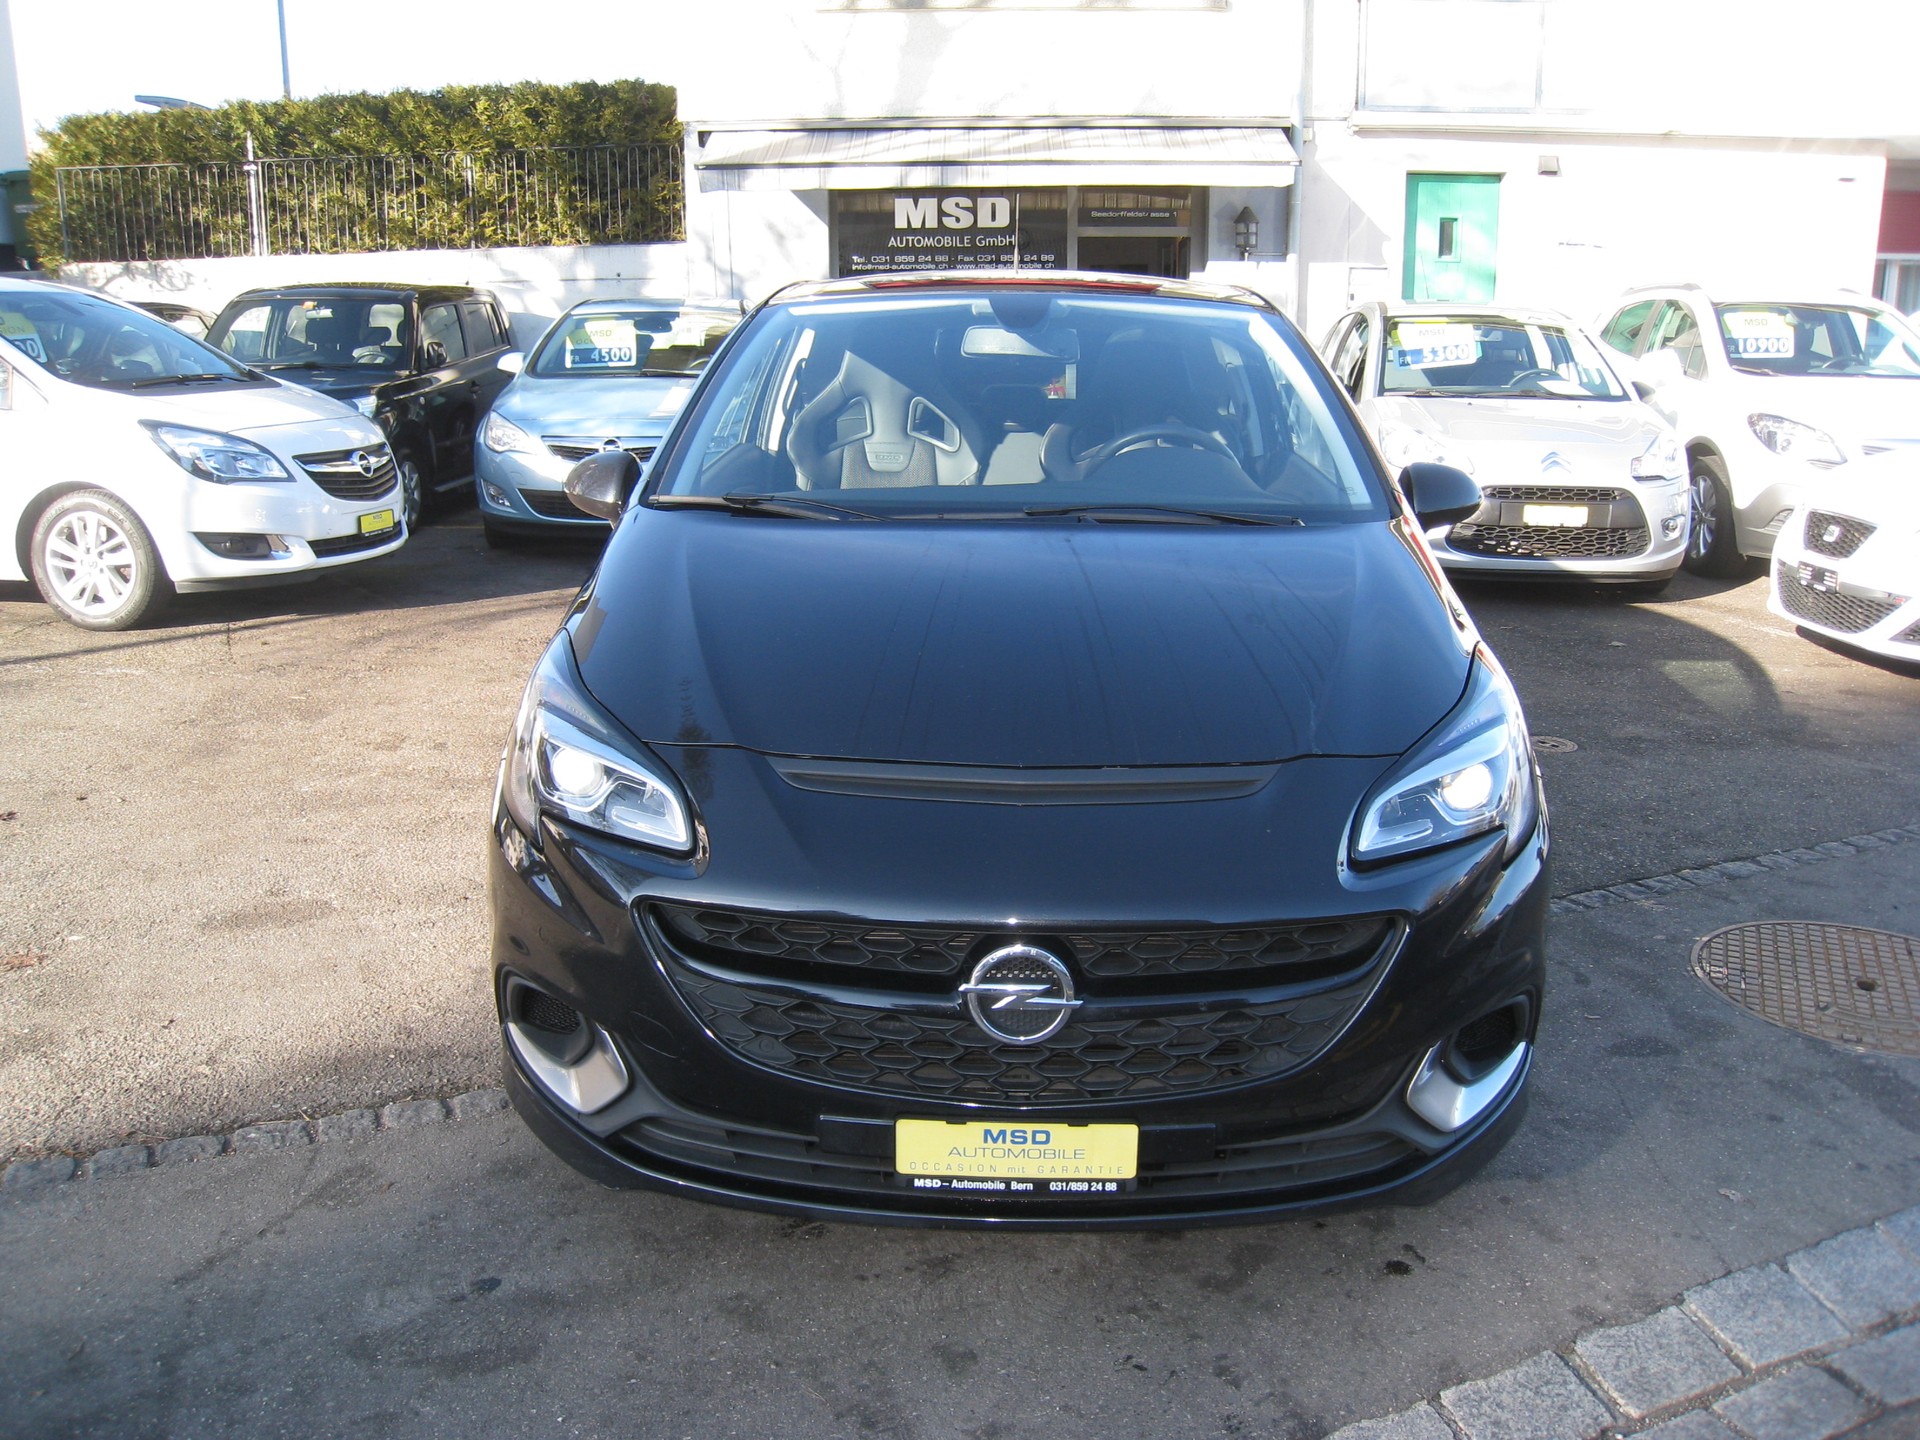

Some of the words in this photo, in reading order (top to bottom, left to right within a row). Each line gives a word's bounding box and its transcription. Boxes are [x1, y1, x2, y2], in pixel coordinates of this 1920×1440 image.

[894, 197, 1010, 229] MSD
[888, 235, 971, 248] AUTOMOBILE
[976, 235, 1015, 247] GmbH
[852, 255, 868, 263] Tel.
[871, 255, 890, 263] 031
[894, 255, 915, 263] 859
[918, 255, 932, 263] 24
[934, 254, 949, 262] 88
[957, 254, 975, 262] Fax
[976, 254, 996, 262] 031
[1000, 254, 1021, 262] 85
[1738, 338, 1789, 353] 10900
[590, 347, 630, 362] 4500
[1422, 344, 1470, 363] 5300
[983, 1129, 1051, 1145] MSD
[947, 1146, 1086, 1160] AUTOMOBILE
[909, 1161, 997, 1173] OCCASION
[1007, 1166, 1026, 1174] mit
[1037, 1165, 1124, 1175] GARANTIE
[913, 1178, 942, 1188] MSD
[951, 1179, 1006, 1191] Automobile
[1010, 1181, 1034, 1191] Bern
[1049, 1182, 1089, 1191] 031/859
[1090, 1182, 1103, 1191] 24
[1104, 1182, 1117, 1191] 88
